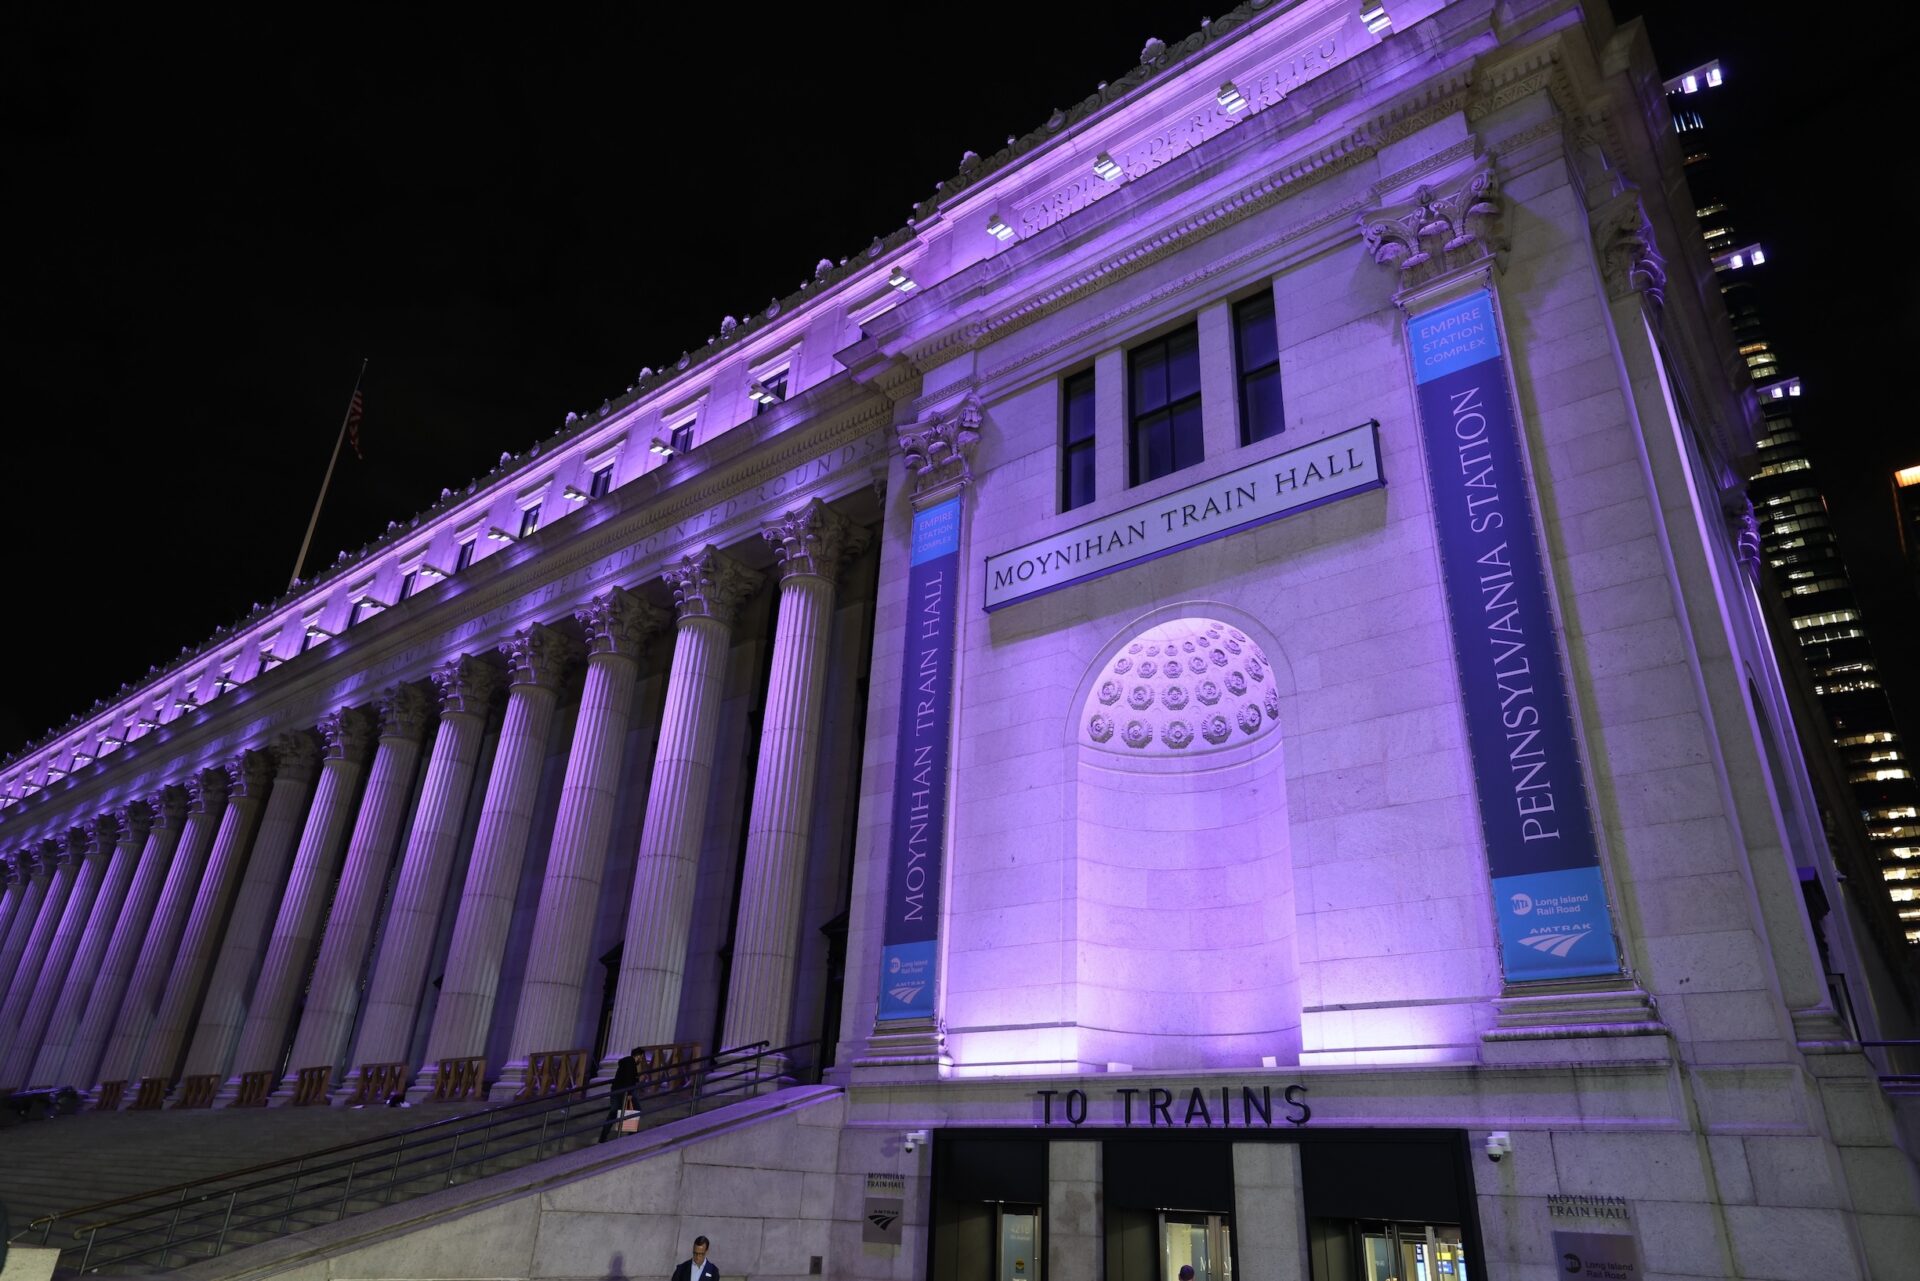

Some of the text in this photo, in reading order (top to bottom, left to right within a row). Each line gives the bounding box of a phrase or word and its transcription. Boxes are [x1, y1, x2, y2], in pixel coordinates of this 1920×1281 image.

[1023, 153, 1137, 223] CARDINL
[1421, 307, 1481, 339] EMPIRE
[1422, 322, 1484, 353] STATION
[1425, 337, 1486, 366] COMPLEX
[603, 500, 737, 575] APPOINTED
[754, 434, 875, 505] ROUNDS
[919, 510, 953, 531] EMPIRE
[994, 447, 1364, 591] MOYNIHAN TRAIN HALL
[918, 524, 953, 543] STATION
[1450, 386, 1560, 844] PENNSYLVANIA STATION
[904, 571, 942, 922] MOYNIHAN TRAIN HALL
[1535, 894, 1589, 907] Long Island
[1536, 905, 1581, 916] Rail Road
[1529, 923, 1592, 934] AMTRAK
[1037, 1085, 1311, 1125] TO TRAINS
[1547, 1194, 1626, 1206] MOYNIHAN
[1547, 1205, 1630, 1220] TRAIN HALL
[1585, 1261, 1606, 1271] Long
[1607, 1262, 1634, 1272] Island
[1604, 1271, 1627, 1280] Road
